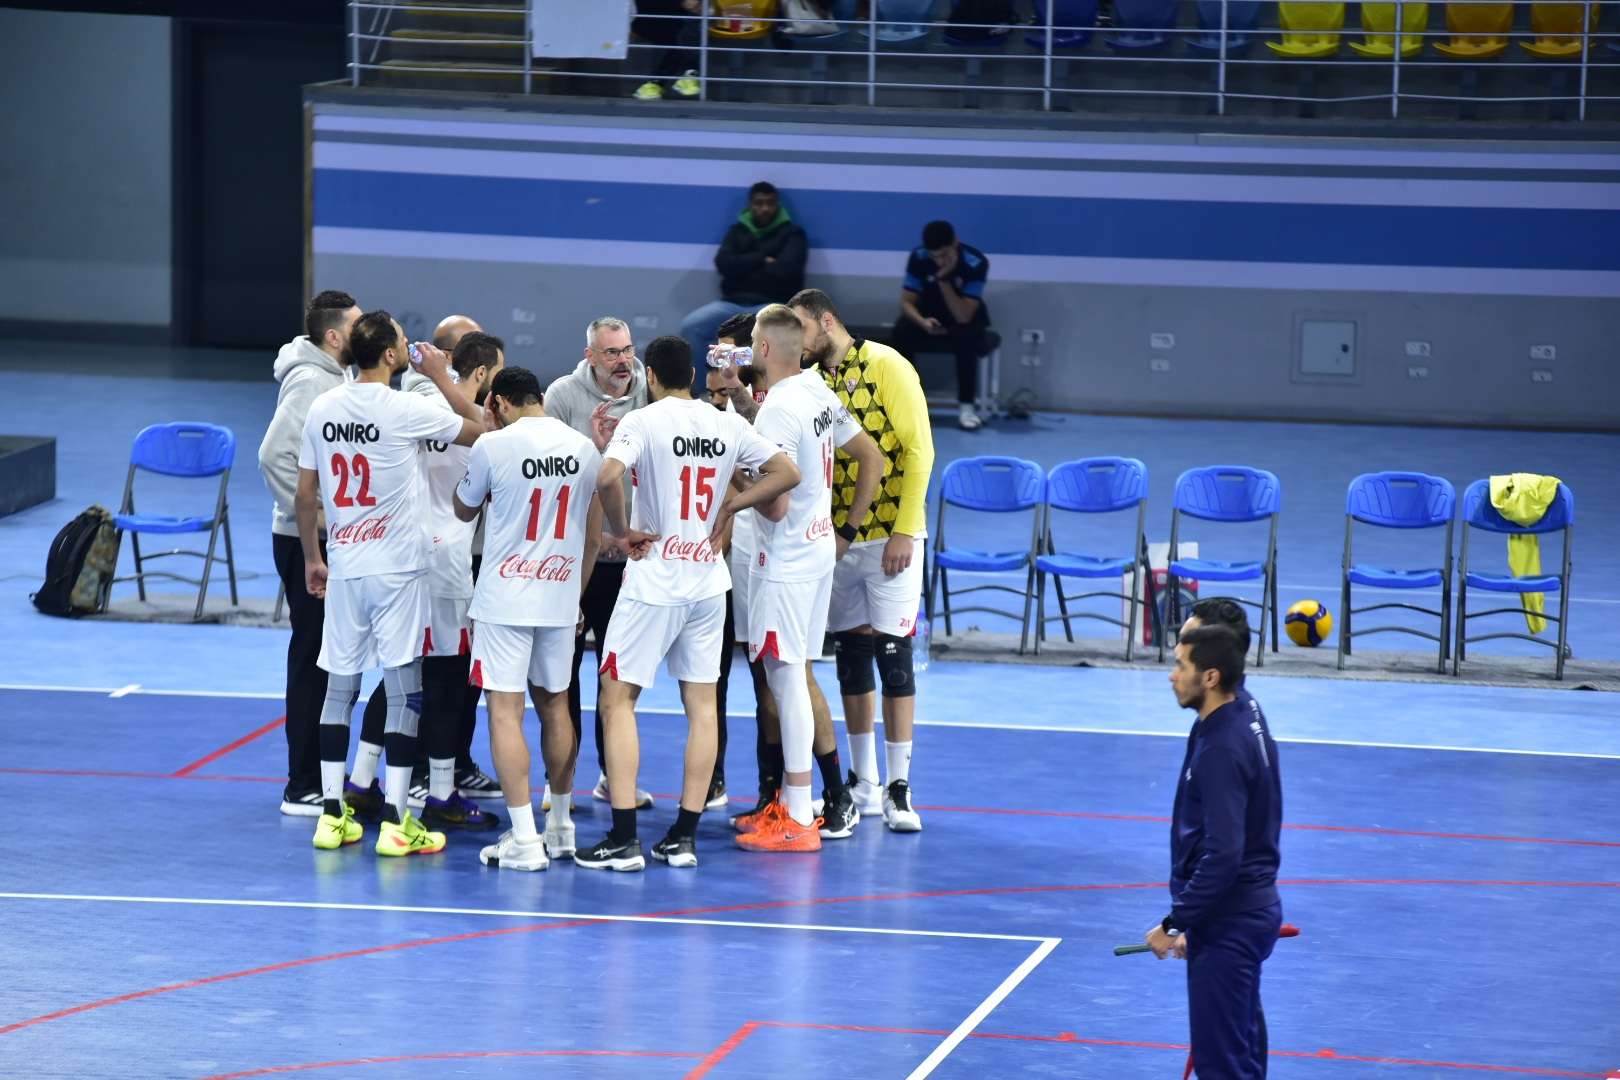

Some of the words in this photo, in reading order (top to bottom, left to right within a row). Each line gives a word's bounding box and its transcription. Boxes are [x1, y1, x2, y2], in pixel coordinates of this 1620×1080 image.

[322, 421, 380, 445] ONIRO
[672, 436, 726, 459] ONIRO
[331, 452, 377, 508] 22
[522, 454, 579, 480] ONIRO
[679, 465, 716, 522] 15
[525, 485, 570, 541] 11
[330, 514, 392, 545] Cca-Cola
[662, 534, 720, 563] Coca-Co
